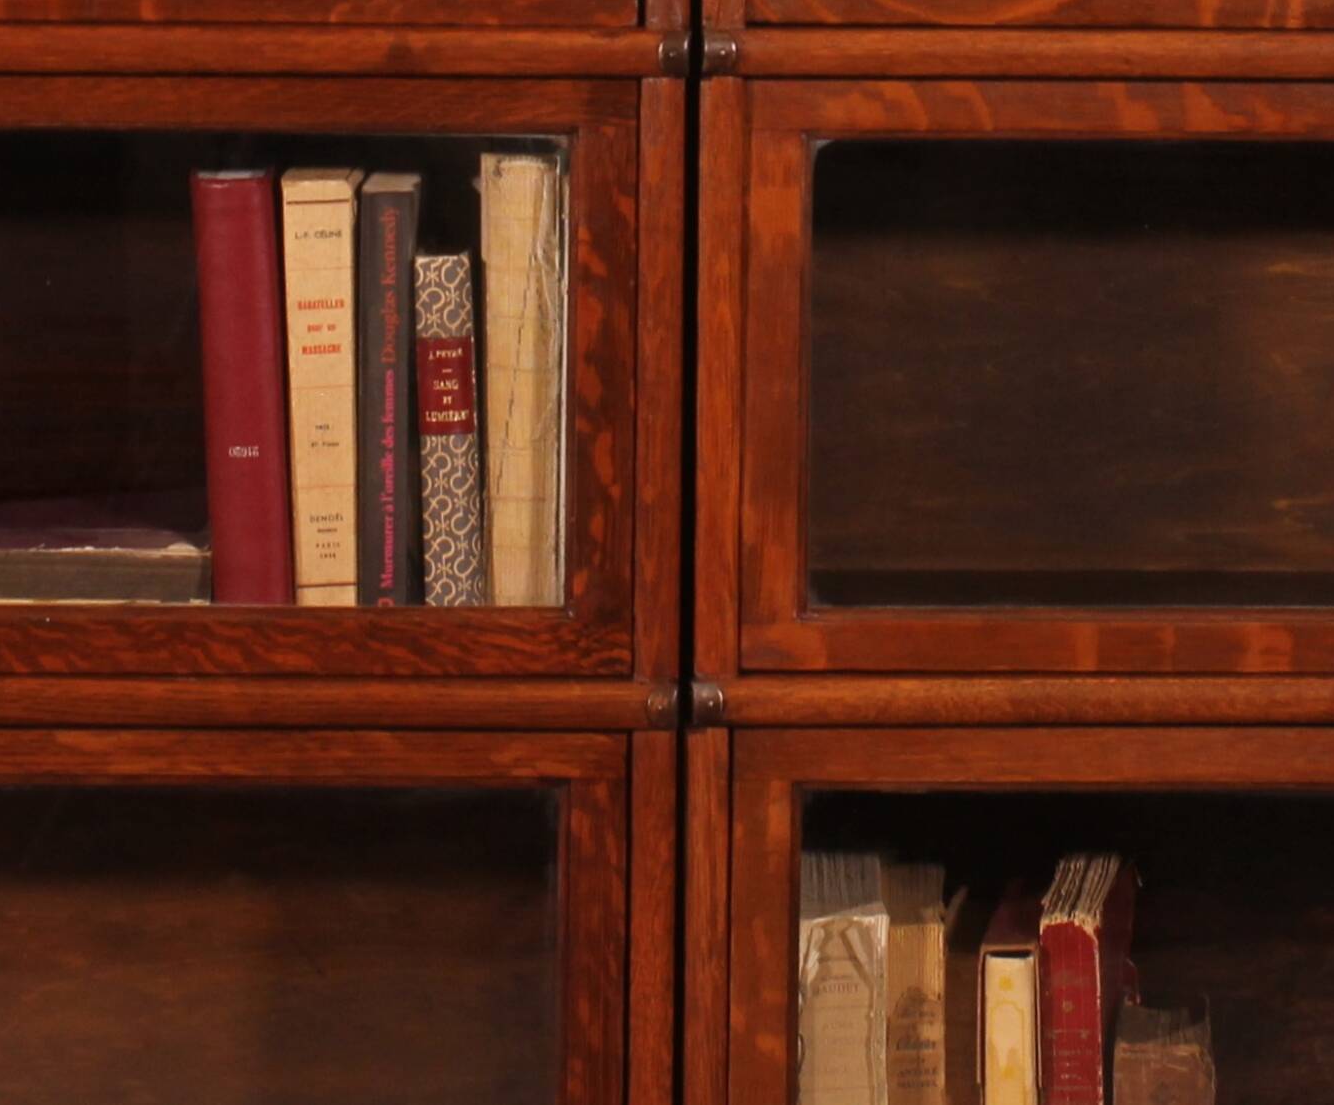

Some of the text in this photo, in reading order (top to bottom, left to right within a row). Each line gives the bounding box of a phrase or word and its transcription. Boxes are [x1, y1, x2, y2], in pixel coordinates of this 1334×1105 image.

[380, 207, 400, 364] Douglas Kennedy
[380, 368, 395, 424] femmes
[433, 379, 459, 391] SANG
[381, 426, 395, 449] des
